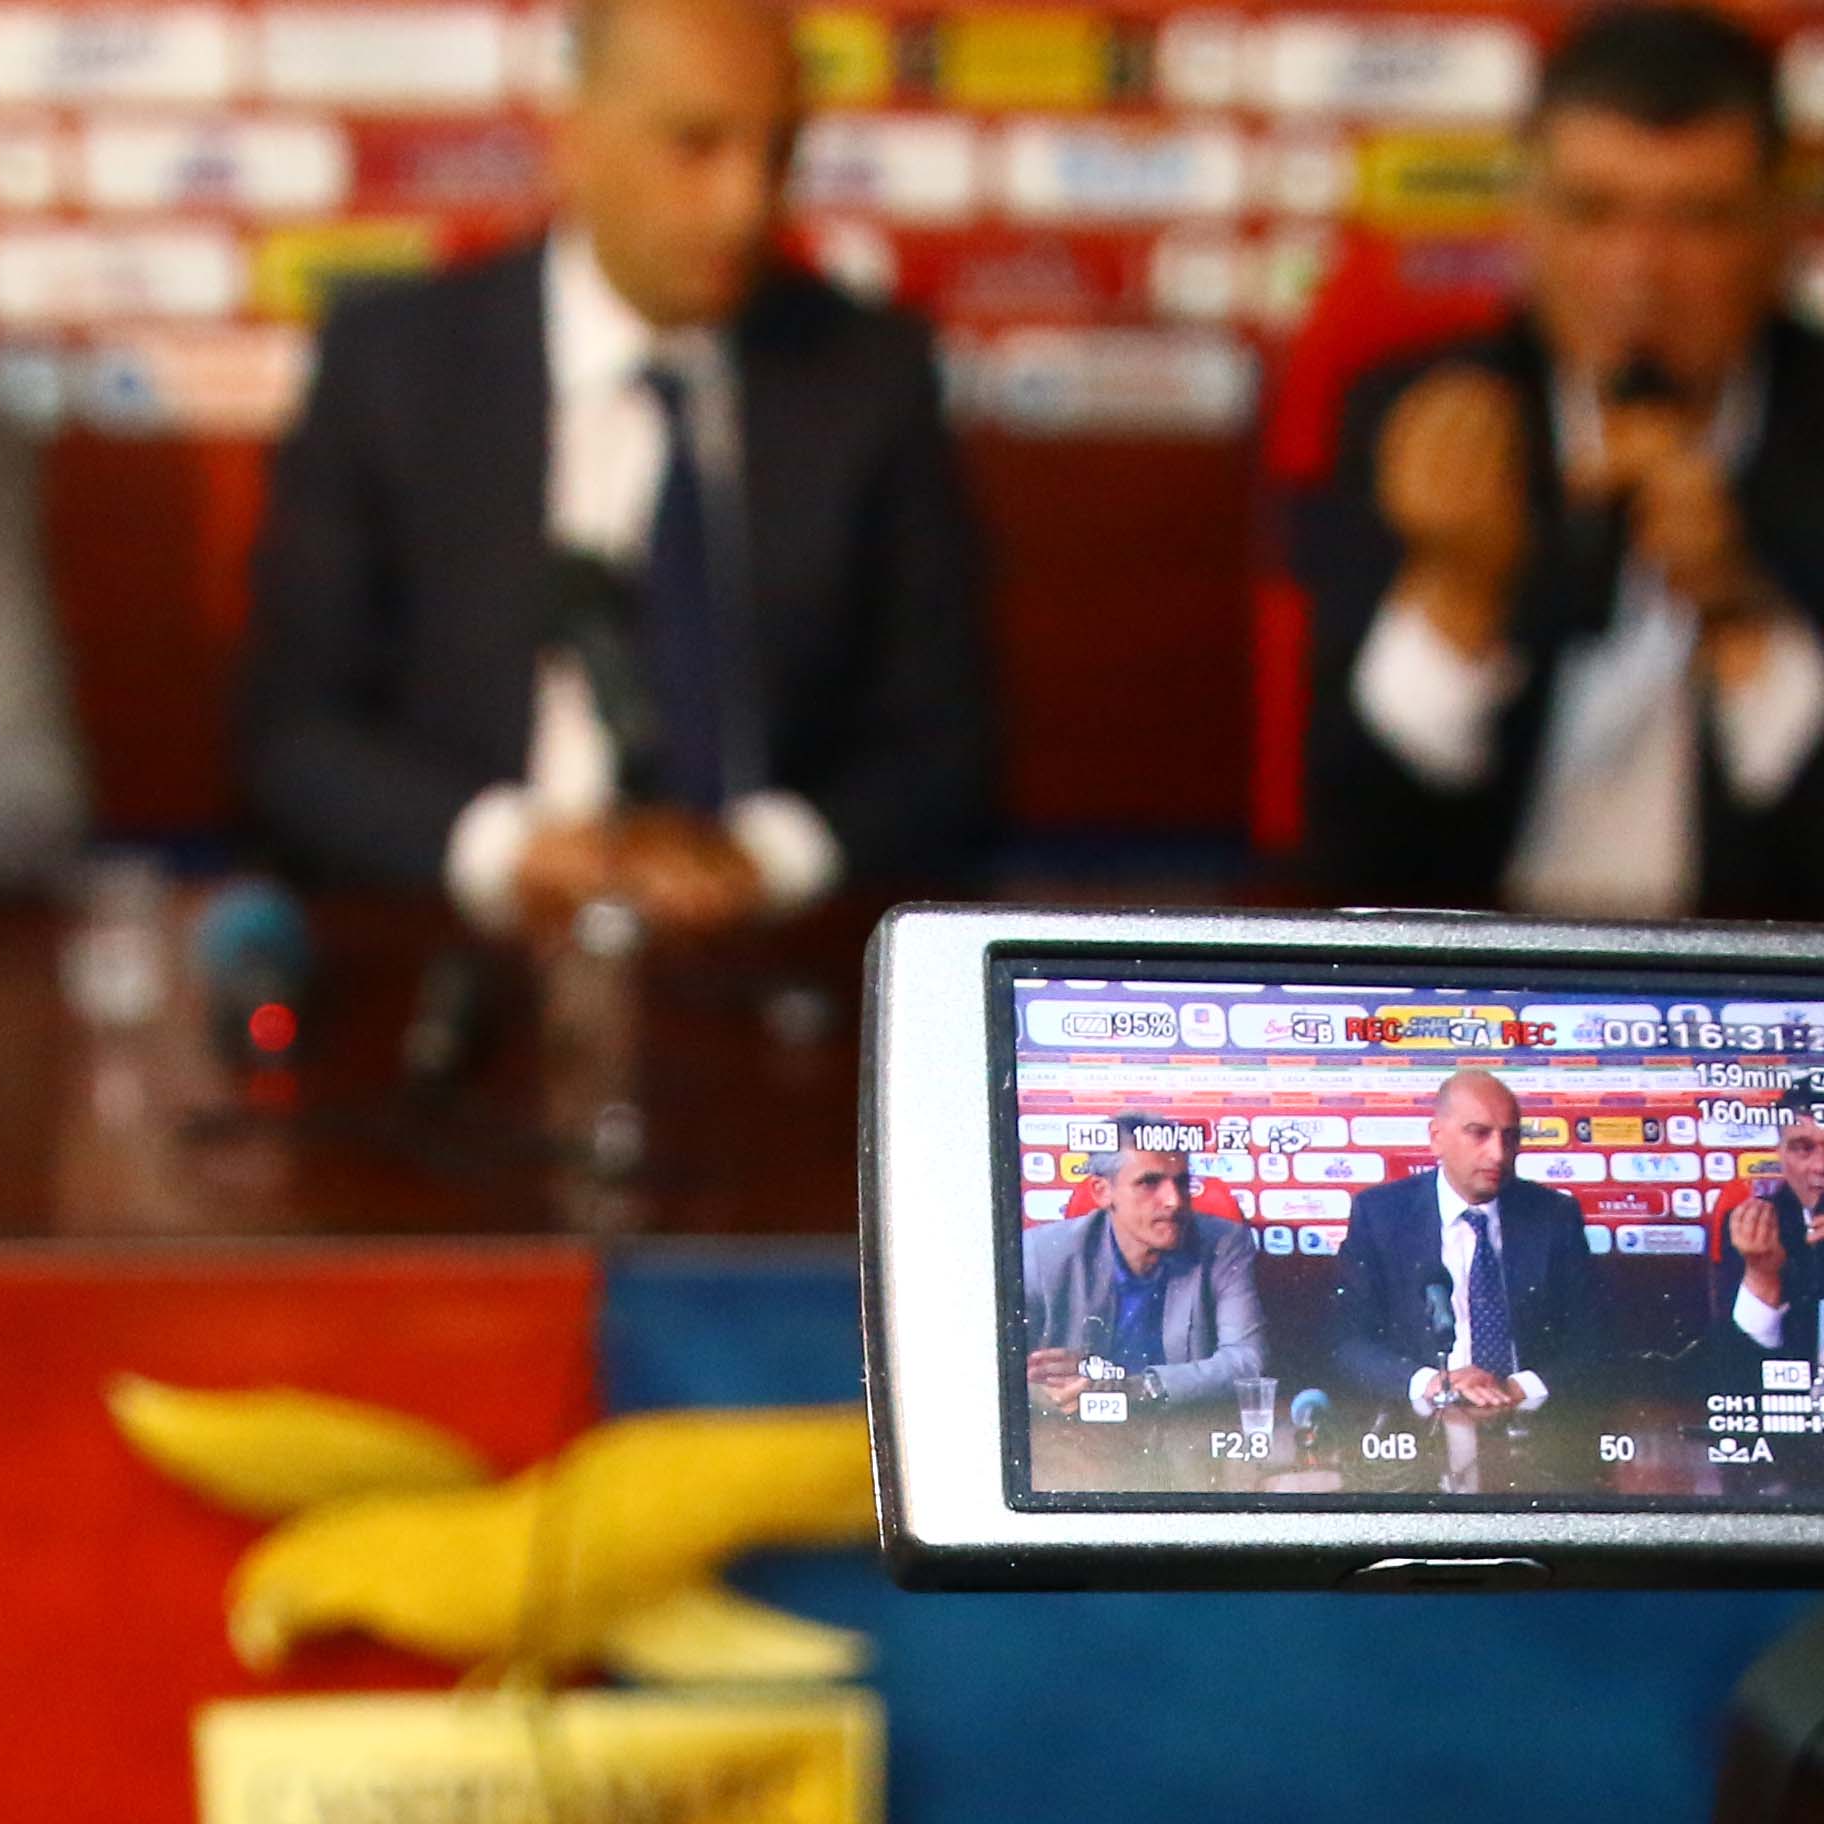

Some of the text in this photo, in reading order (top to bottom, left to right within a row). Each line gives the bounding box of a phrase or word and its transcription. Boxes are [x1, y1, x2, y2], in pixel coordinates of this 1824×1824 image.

[1113, 1010, 1175, 1037] 95%
[1345, 1016, 1403, 1043] REC
[1501, 1020, 1557, 1046] REC
[1695, 1062, 1800, 1091] 159min.
[1697, 1100, 1802, 1128] 160min.
[1079, 1129, 1109, 1148] HD
[1133, 1125, 1205, 1153] 1080/50i
[1219, 1130, 1244, 1150] FX
[1773, 1367, 1800, 1384] HD
[1086, 1398, 1121, 1417] PP2
[1706, 1395, 1757, 1413] CH1
[1707, 1415, 1760, 1434] CH2
[1210, 1431, 1270, 1461] F2,8
[1361, 1432, 1419, 1461] 0dB
[1599, 1434, 1635, 1462] 50
[1751, 1437, 1774, 1462] A
